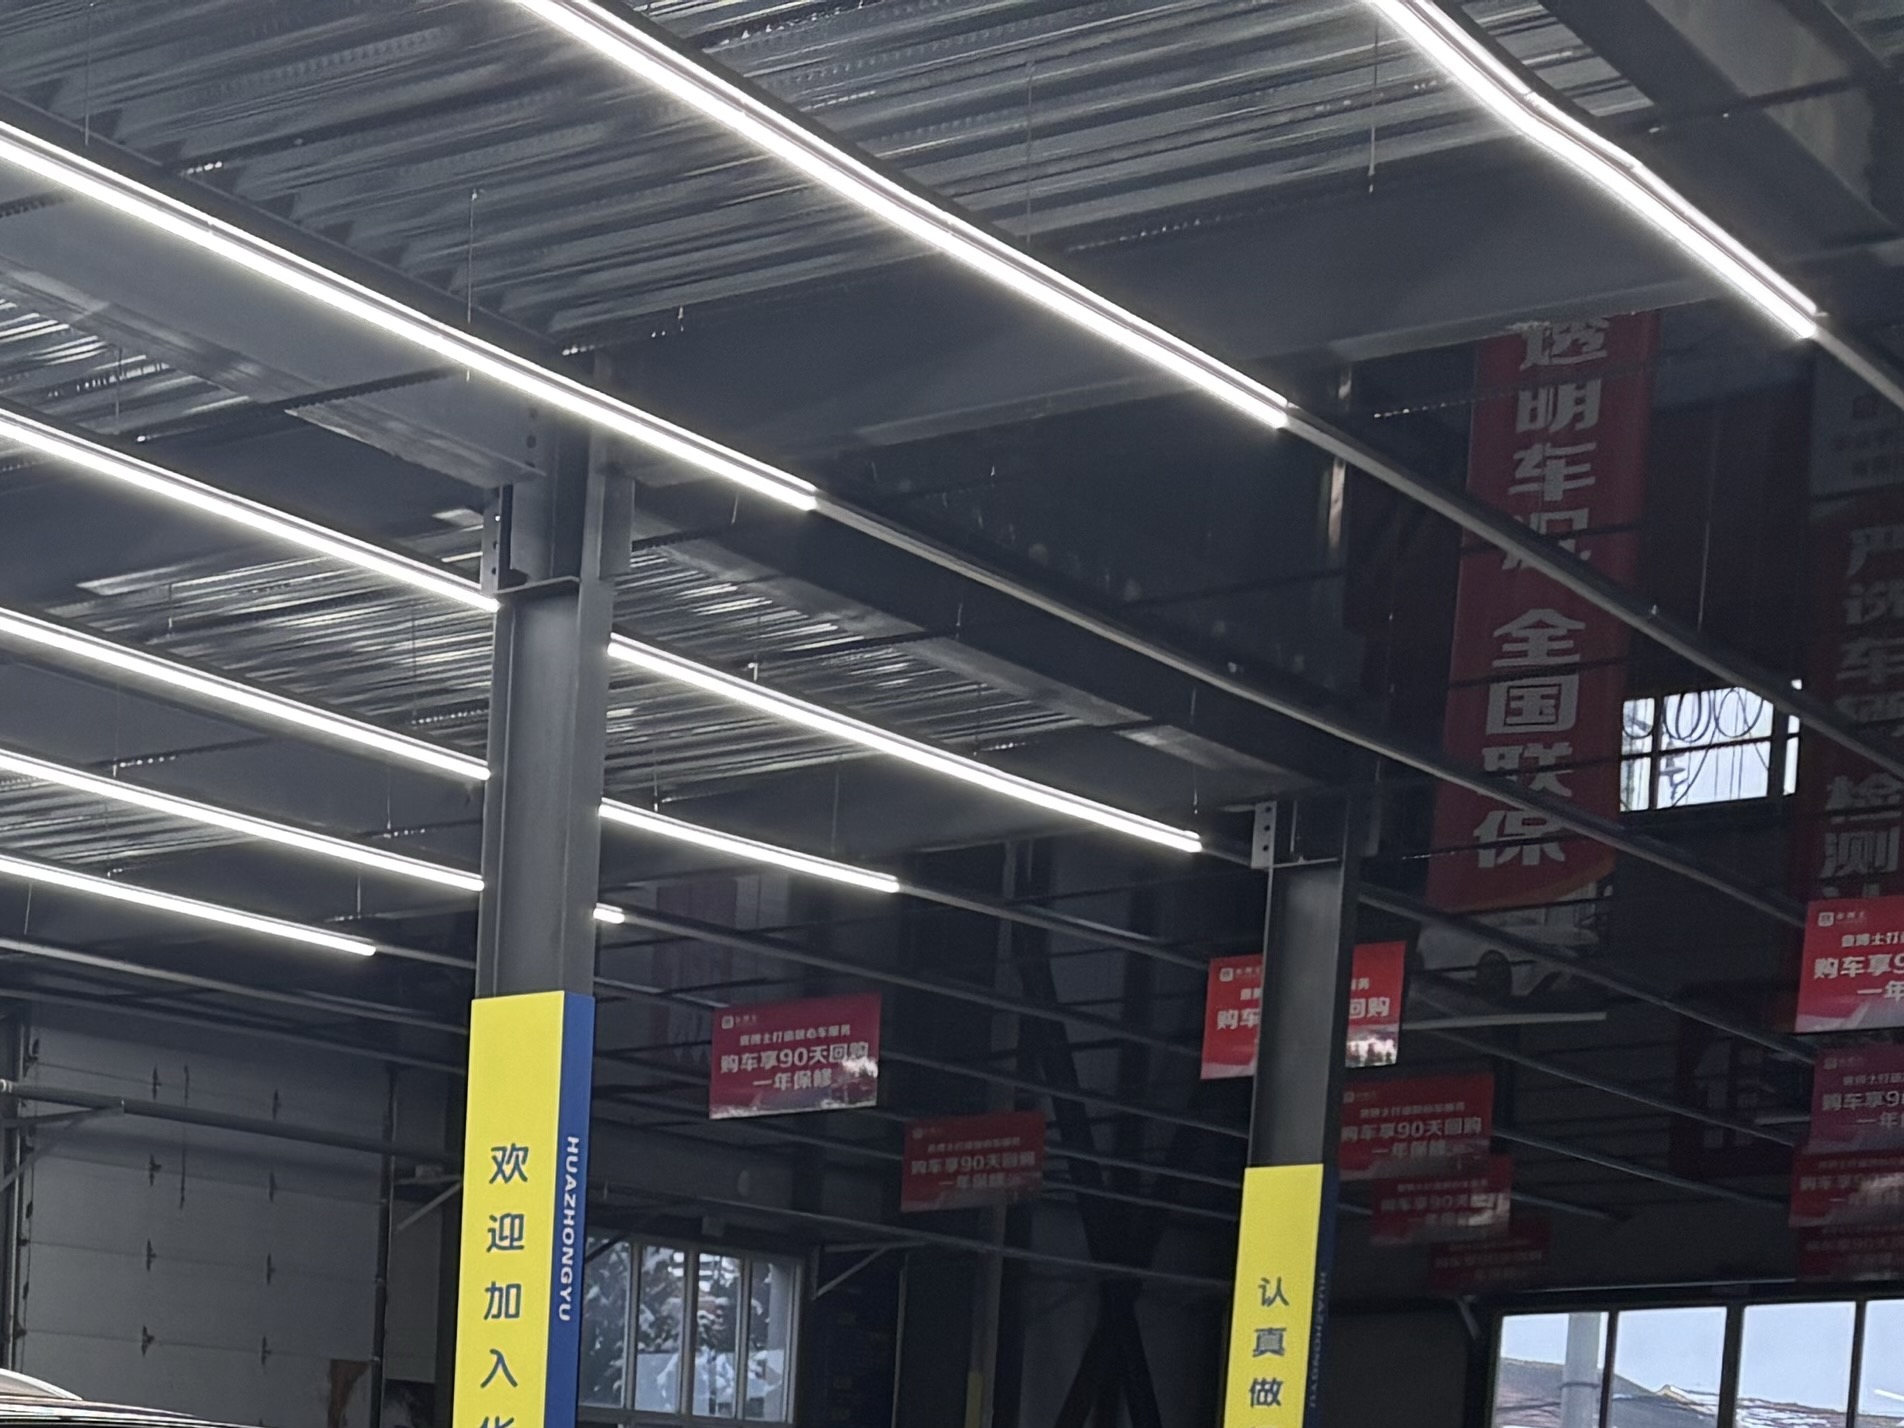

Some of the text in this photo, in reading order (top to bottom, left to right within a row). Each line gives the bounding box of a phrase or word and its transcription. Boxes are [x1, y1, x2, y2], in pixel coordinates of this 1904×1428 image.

[720, 1041, 870, 1074] 购车享90天回购
[557, 1136, 581, 1322] HUAZHONGYU
